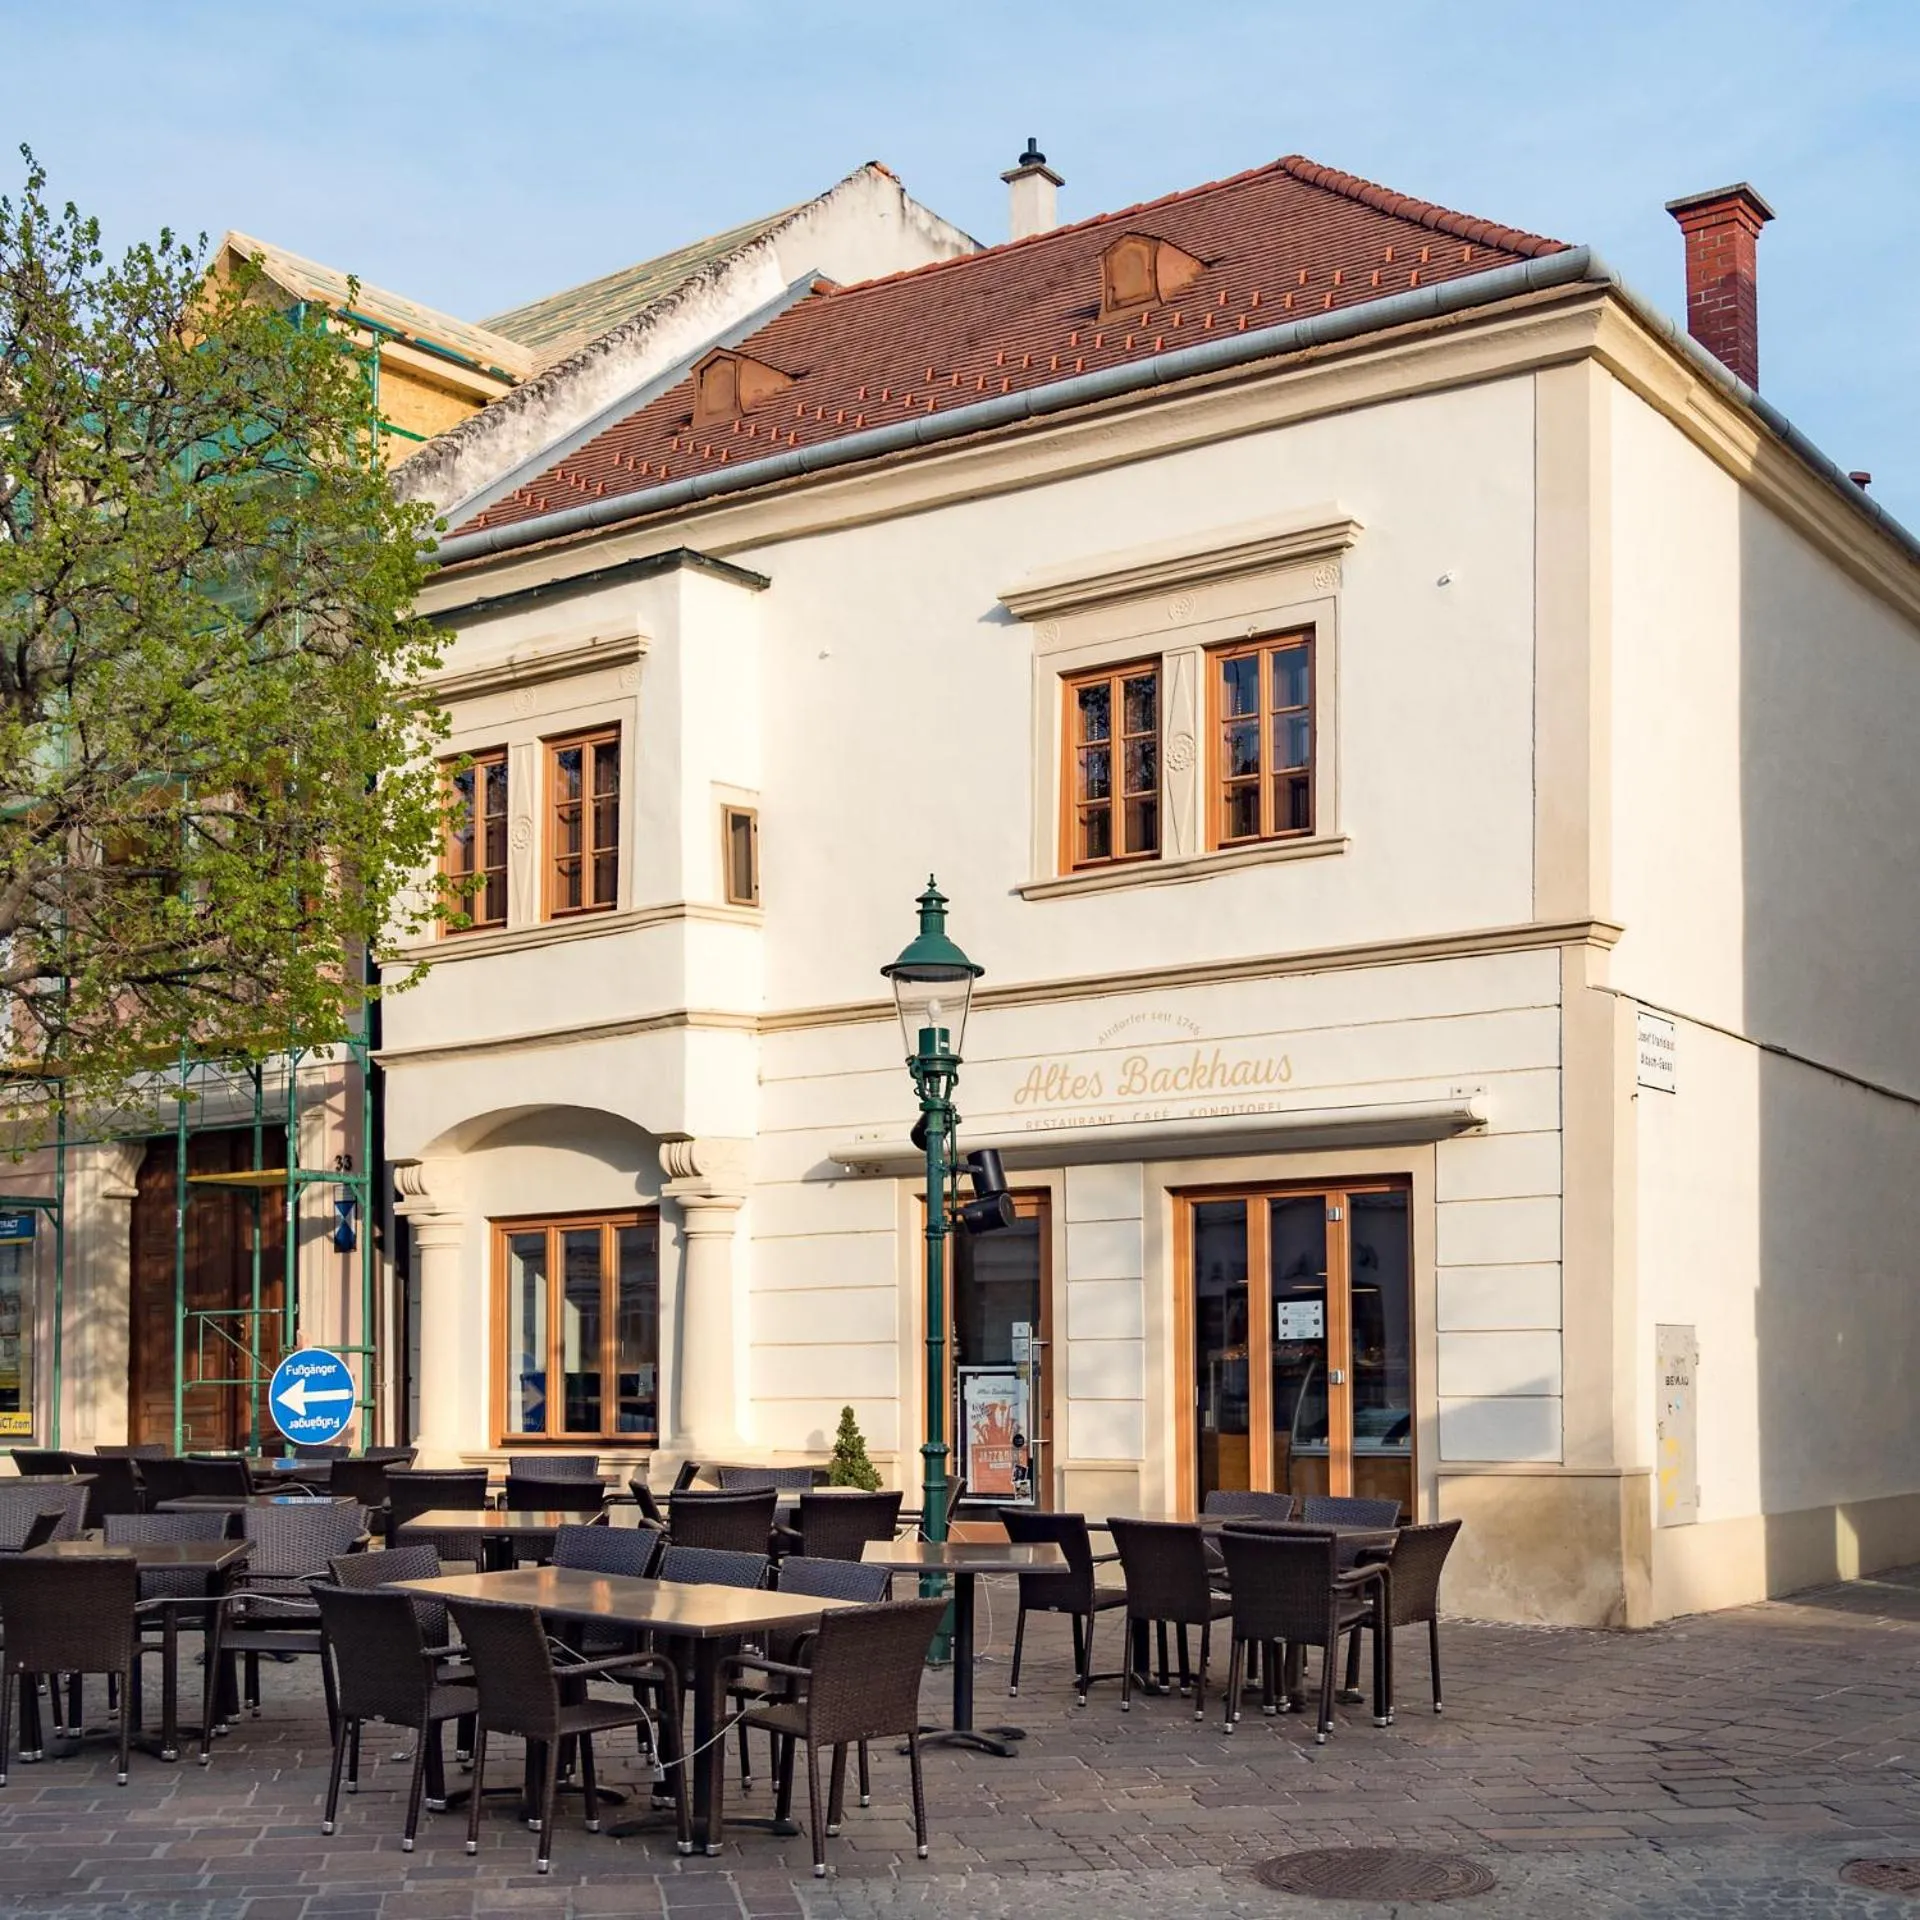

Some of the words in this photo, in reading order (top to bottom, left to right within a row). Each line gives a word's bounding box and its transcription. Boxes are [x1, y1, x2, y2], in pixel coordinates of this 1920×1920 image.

[1014, 1063, 1103, 1106] Altes
[1117, 1048, 1292, 1097] Backhaus
[1026, 1113, 1114, 1129] RESTAURANT
[1188, 1101, 1282, 1117] KONDITOREI
[335, 1154, 353, 1171] 33
[286, 1364, 338, 1377] Fußgänger
[288, 1416, 340, 1429] Fußgänger
